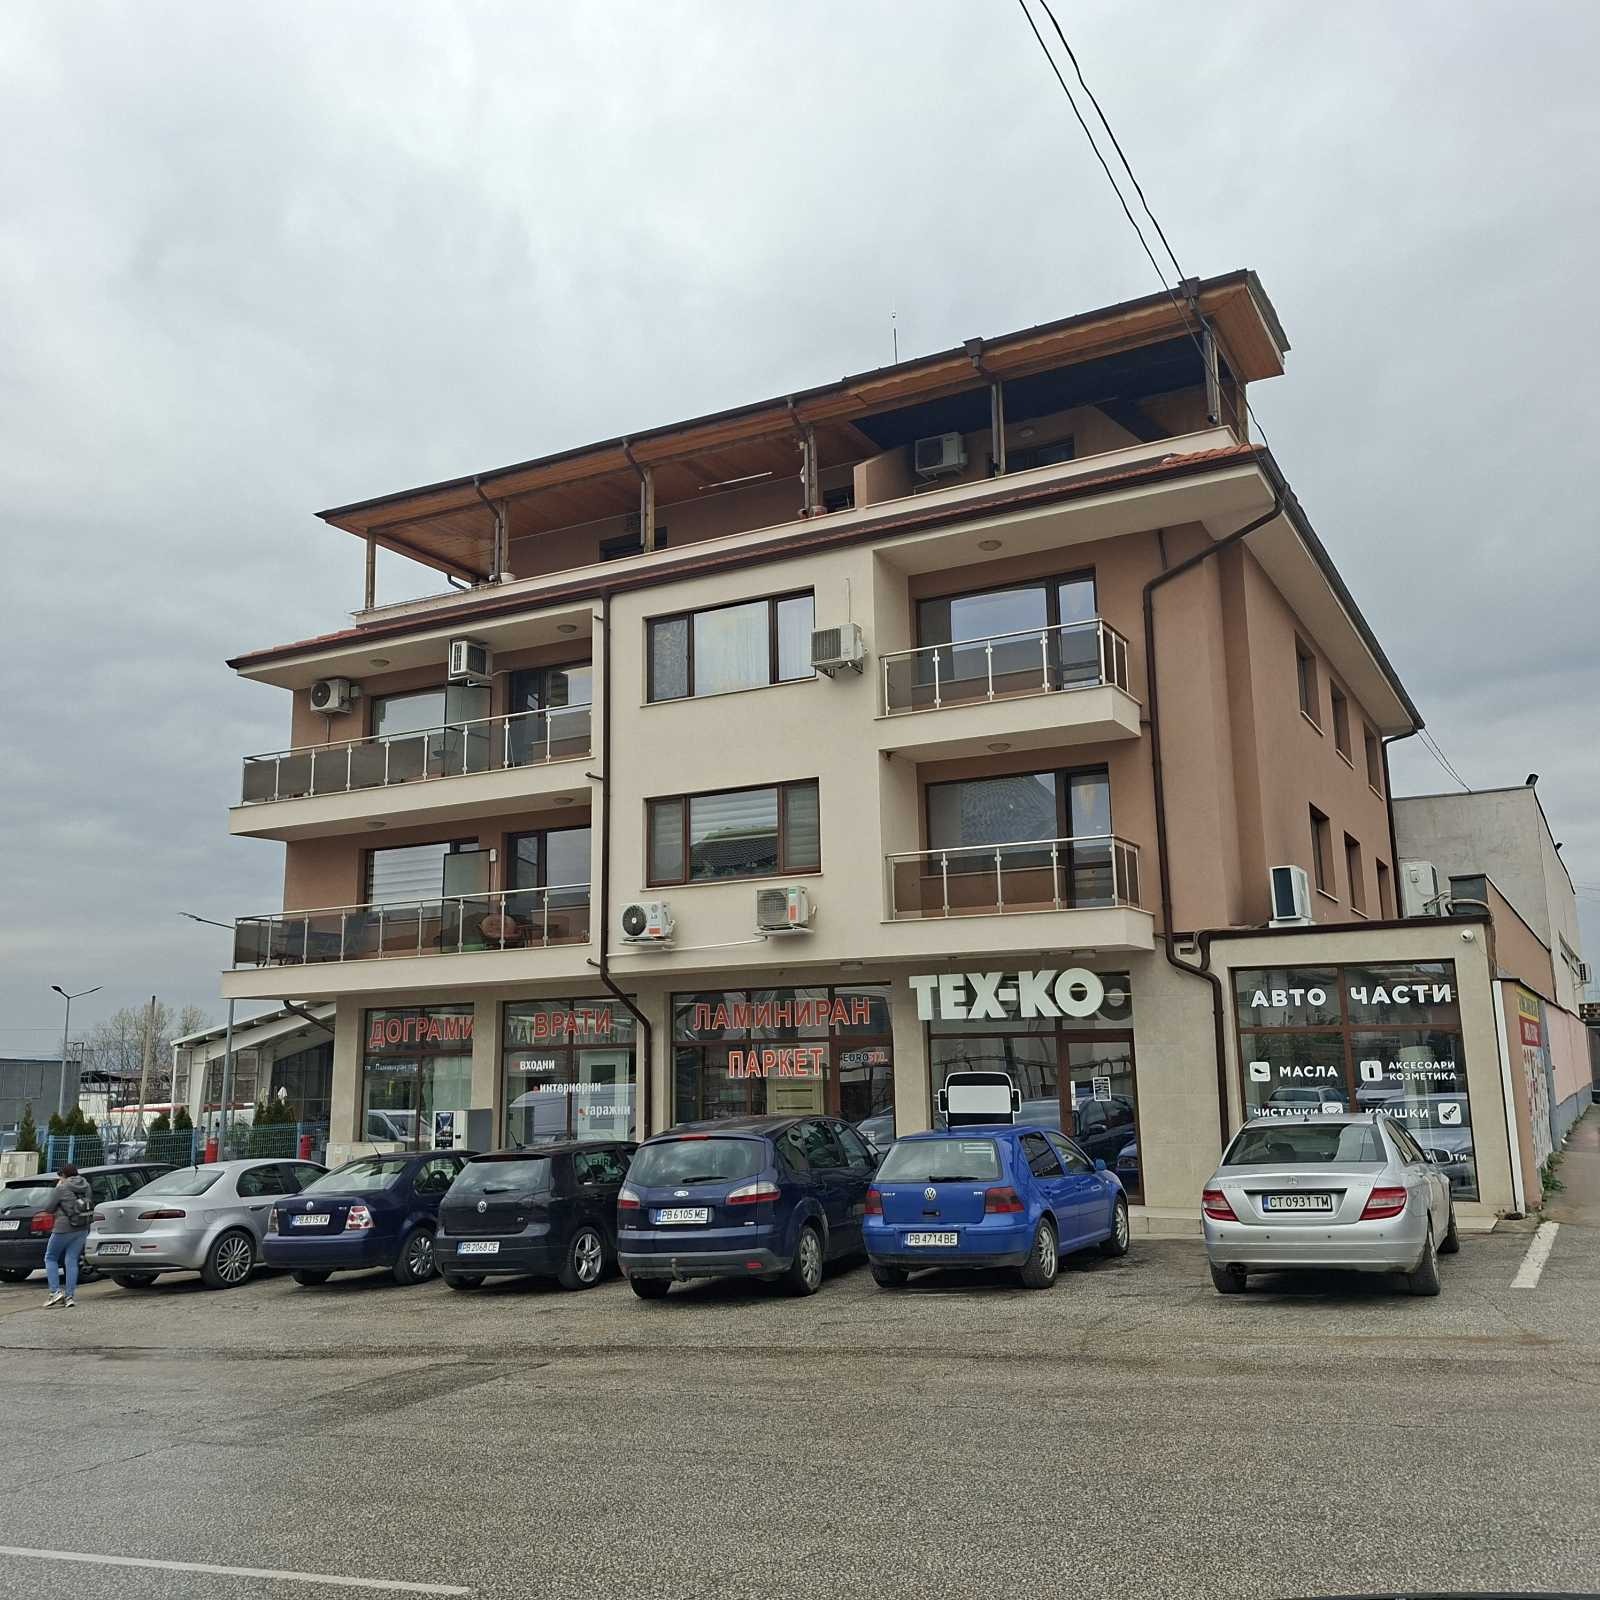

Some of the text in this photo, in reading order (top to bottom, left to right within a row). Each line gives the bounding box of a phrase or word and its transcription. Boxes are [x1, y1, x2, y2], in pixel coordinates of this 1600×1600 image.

[908, 967, 1105, 1021] ТЕХ-КО
[1250, 983, 1452, 1008] АВТО ЧАСТИ
[693, 996, 871, 1031] ЛАМИНИРАН
[533, 1007, 613, 1038] ВРАТИ
[369, 1014, 474, 1048] ДОГРАМИ
[519, 1059, 556, 1072] входни
[728, 1047, 824, 1079] ПАРКЕТ
[1388, 1060, 1456, 1070] АКСЕСОАРИ
[1279, 1065, 1339, 1079] МАСЛА
[1389, 1071, 1457, 1081] КОЗМЕТИКА
[539, 1081, 601, 1094] интериорни
[585, 1104, 631, 1117] гаражни
[1253, 1107, 1319, 1117] ЧИСТАЧКИ
[1269, 1197, 1329, 1208] CT 0931 TM
[909, 1233, 956, 1244] PB 4714 BE
